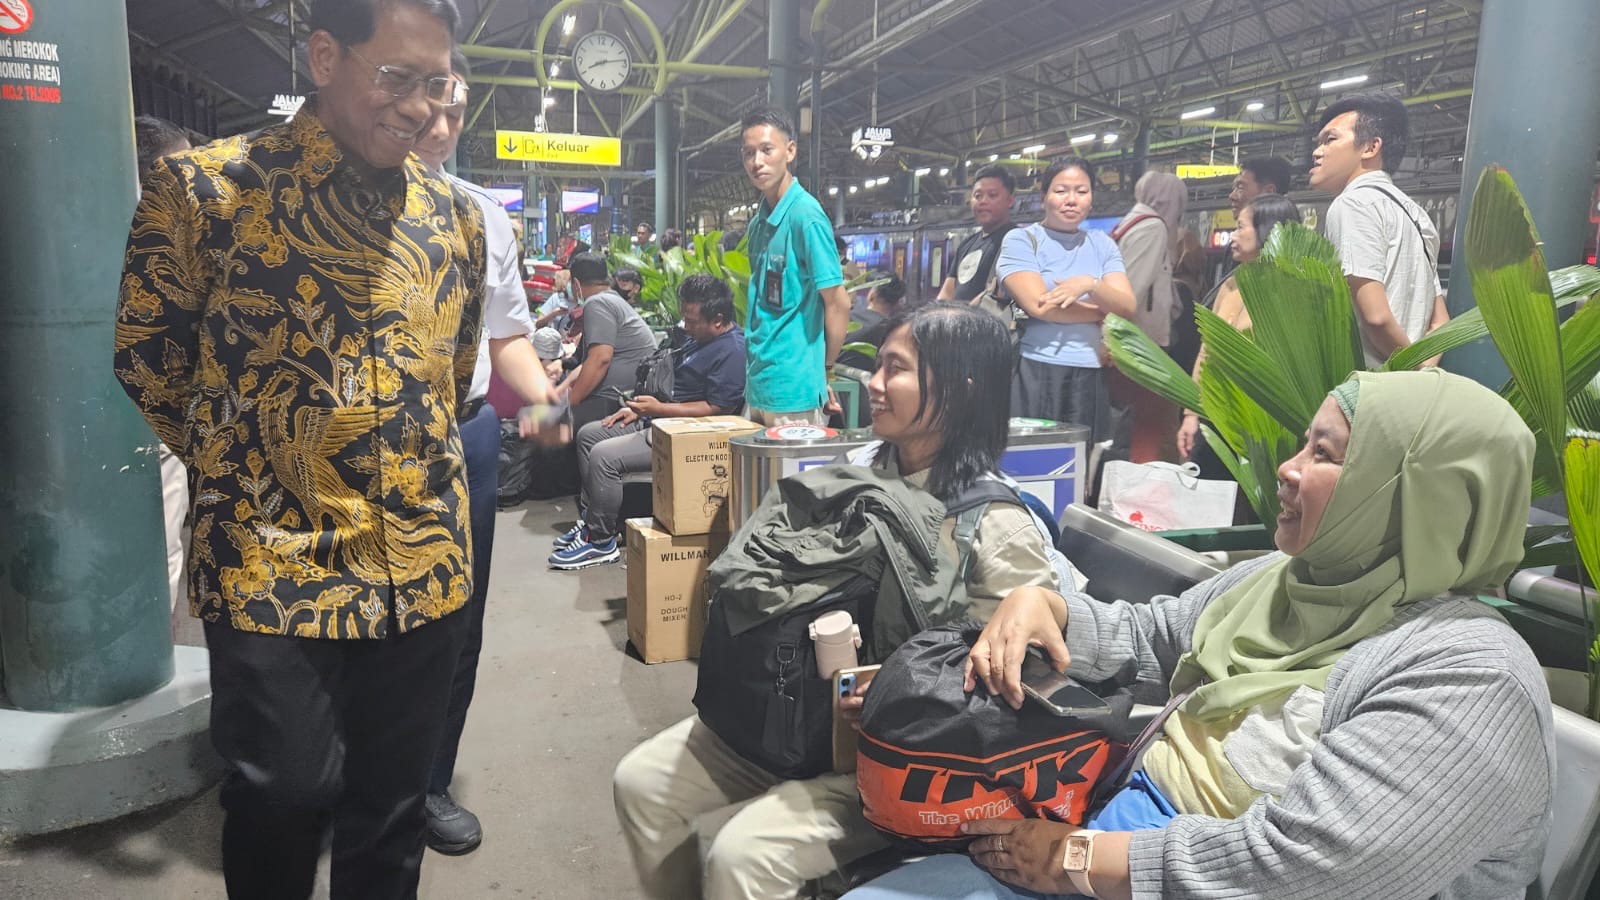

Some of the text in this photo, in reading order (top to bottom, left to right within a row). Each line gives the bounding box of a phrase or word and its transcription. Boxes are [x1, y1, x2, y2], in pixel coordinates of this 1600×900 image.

[13, 40, 59, 61] MEROKOK
[0, 62, 61, 86] OKING AREA)
[547, 140, 590, 153] Keluar
[685, 454, 715, 463] ELECTRIC
[661, 606, 688, 615] DOUGH
[663, 614, 687, 622] MIXER
[919, 811, 960, 825] The
